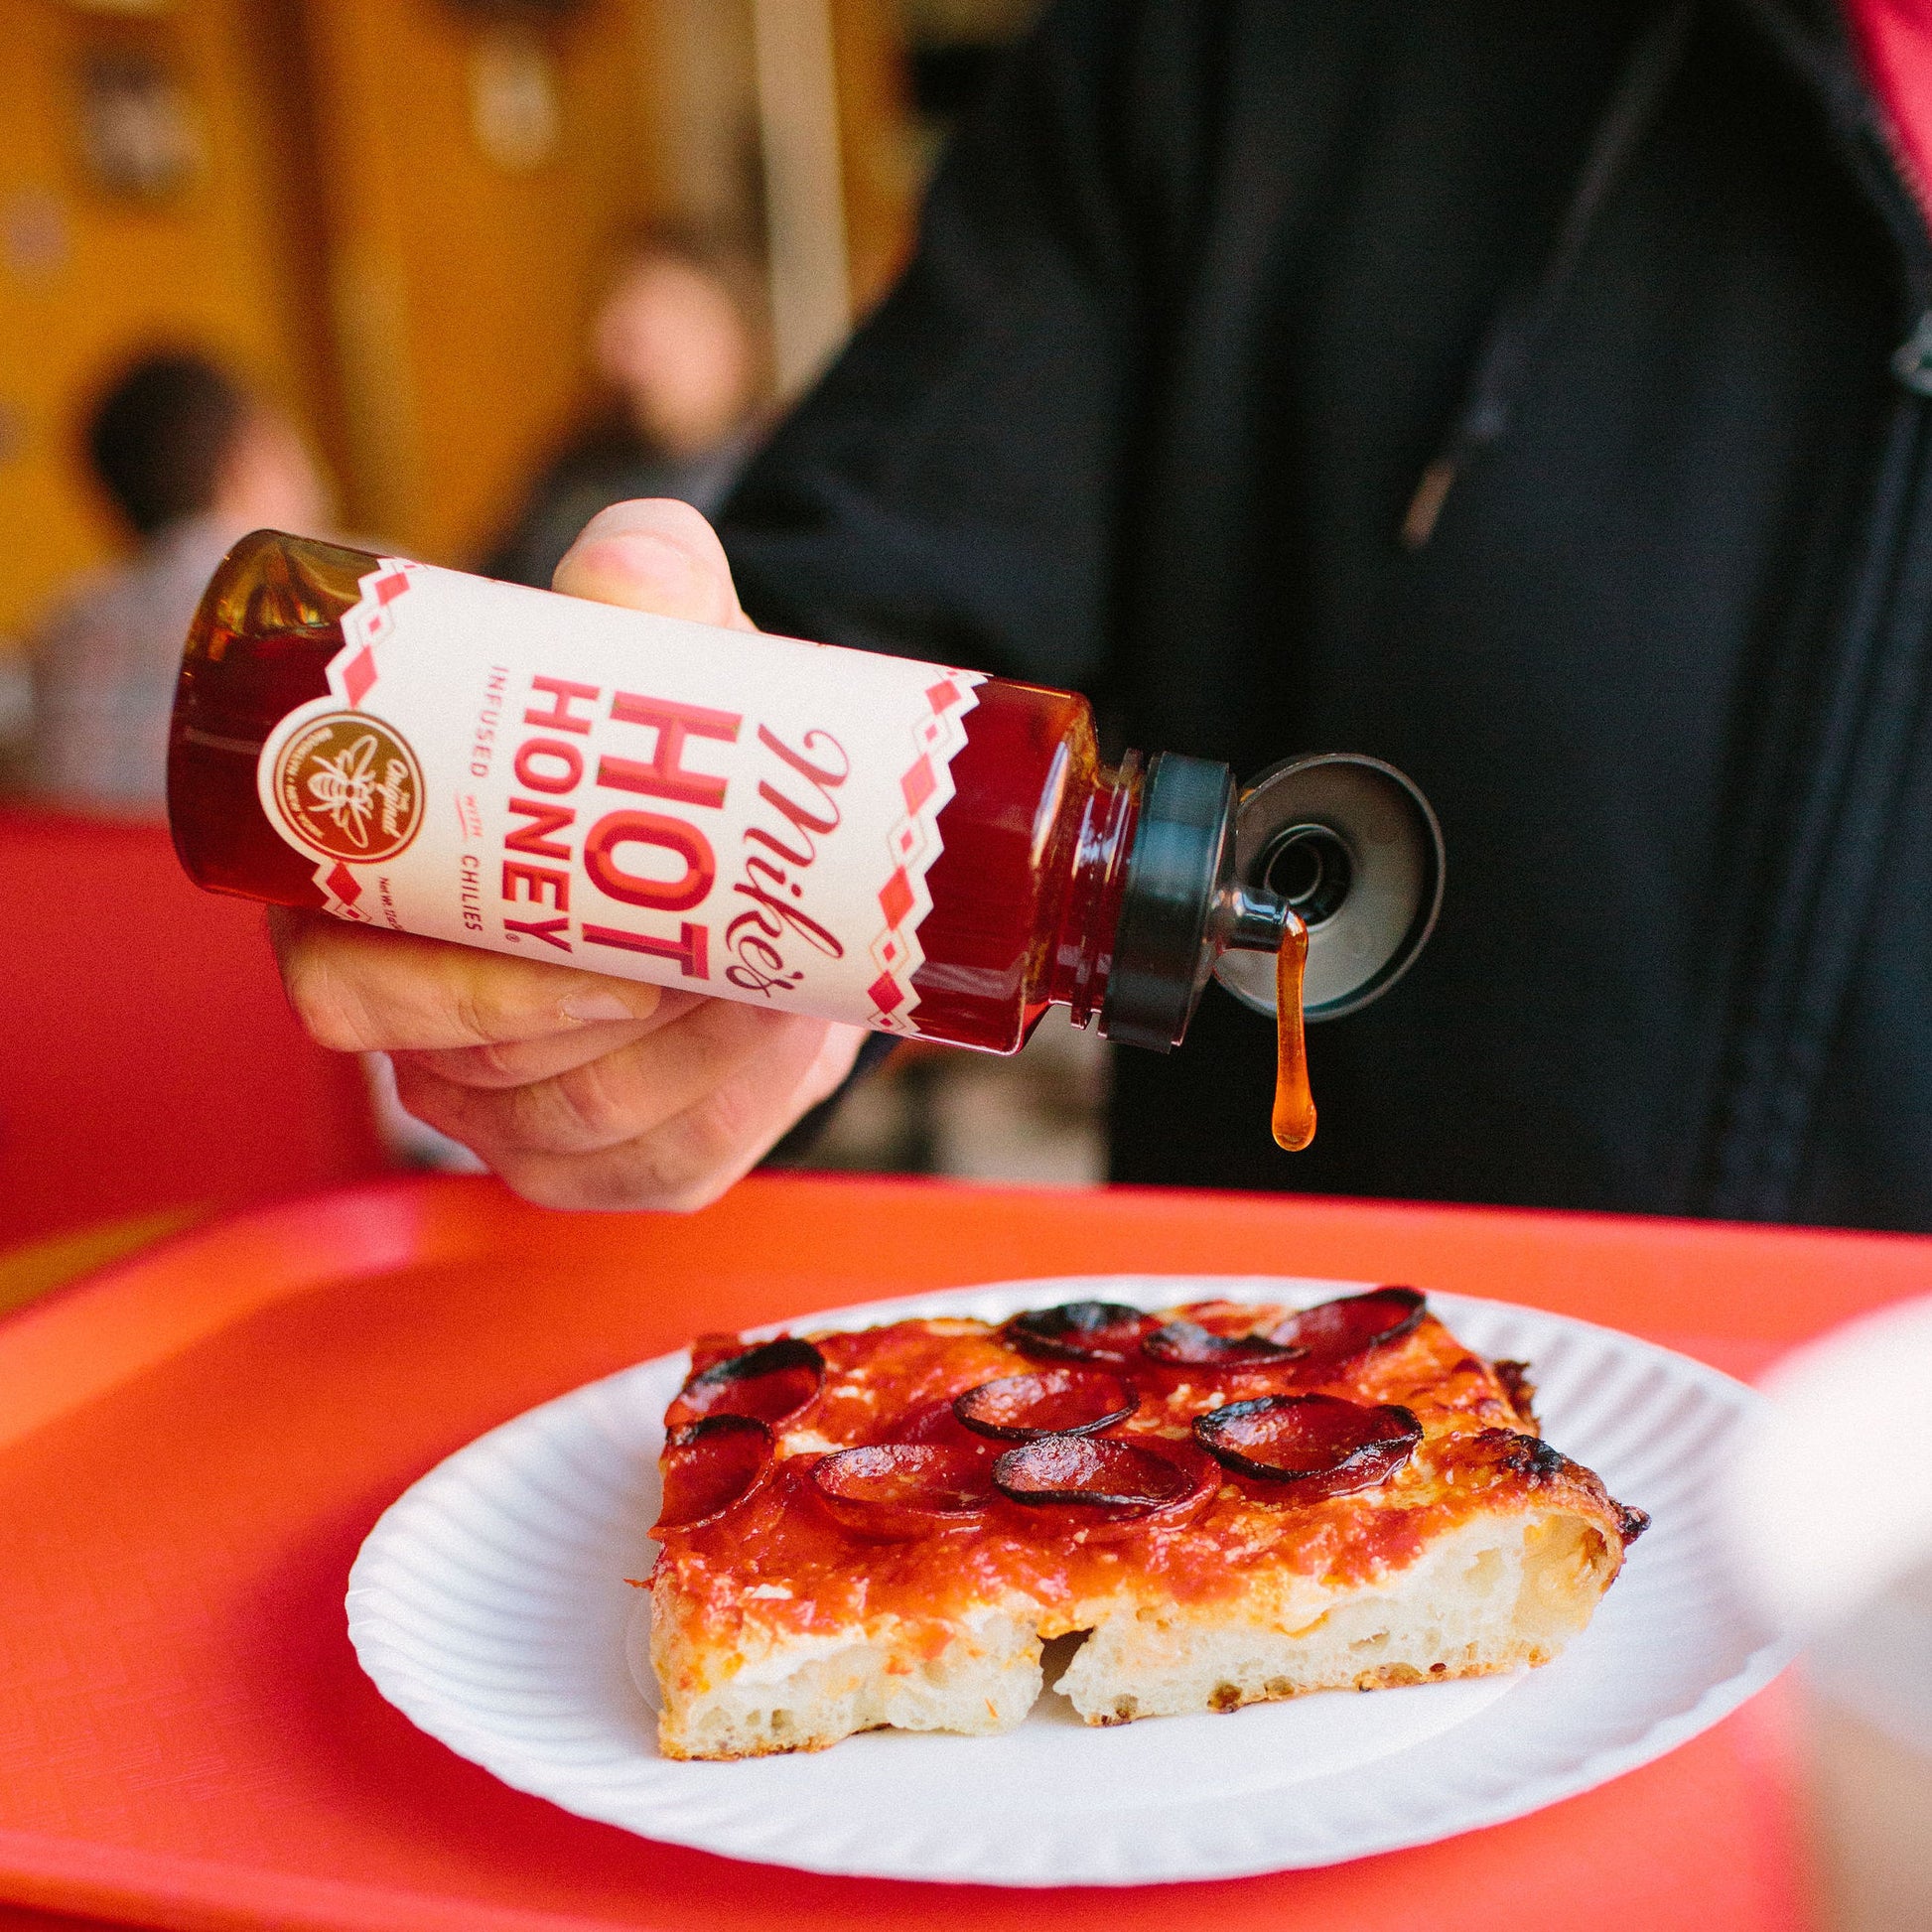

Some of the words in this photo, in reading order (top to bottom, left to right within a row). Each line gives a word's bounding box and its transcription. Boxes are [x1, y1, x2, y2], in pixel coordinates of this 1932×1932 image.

[471, 666, 509, 778] INFUSED
[461, 855, 483, 932] CHILIES
[582, 691, 744, 980] HOT
[725, 723, 850, 998] Mike's
